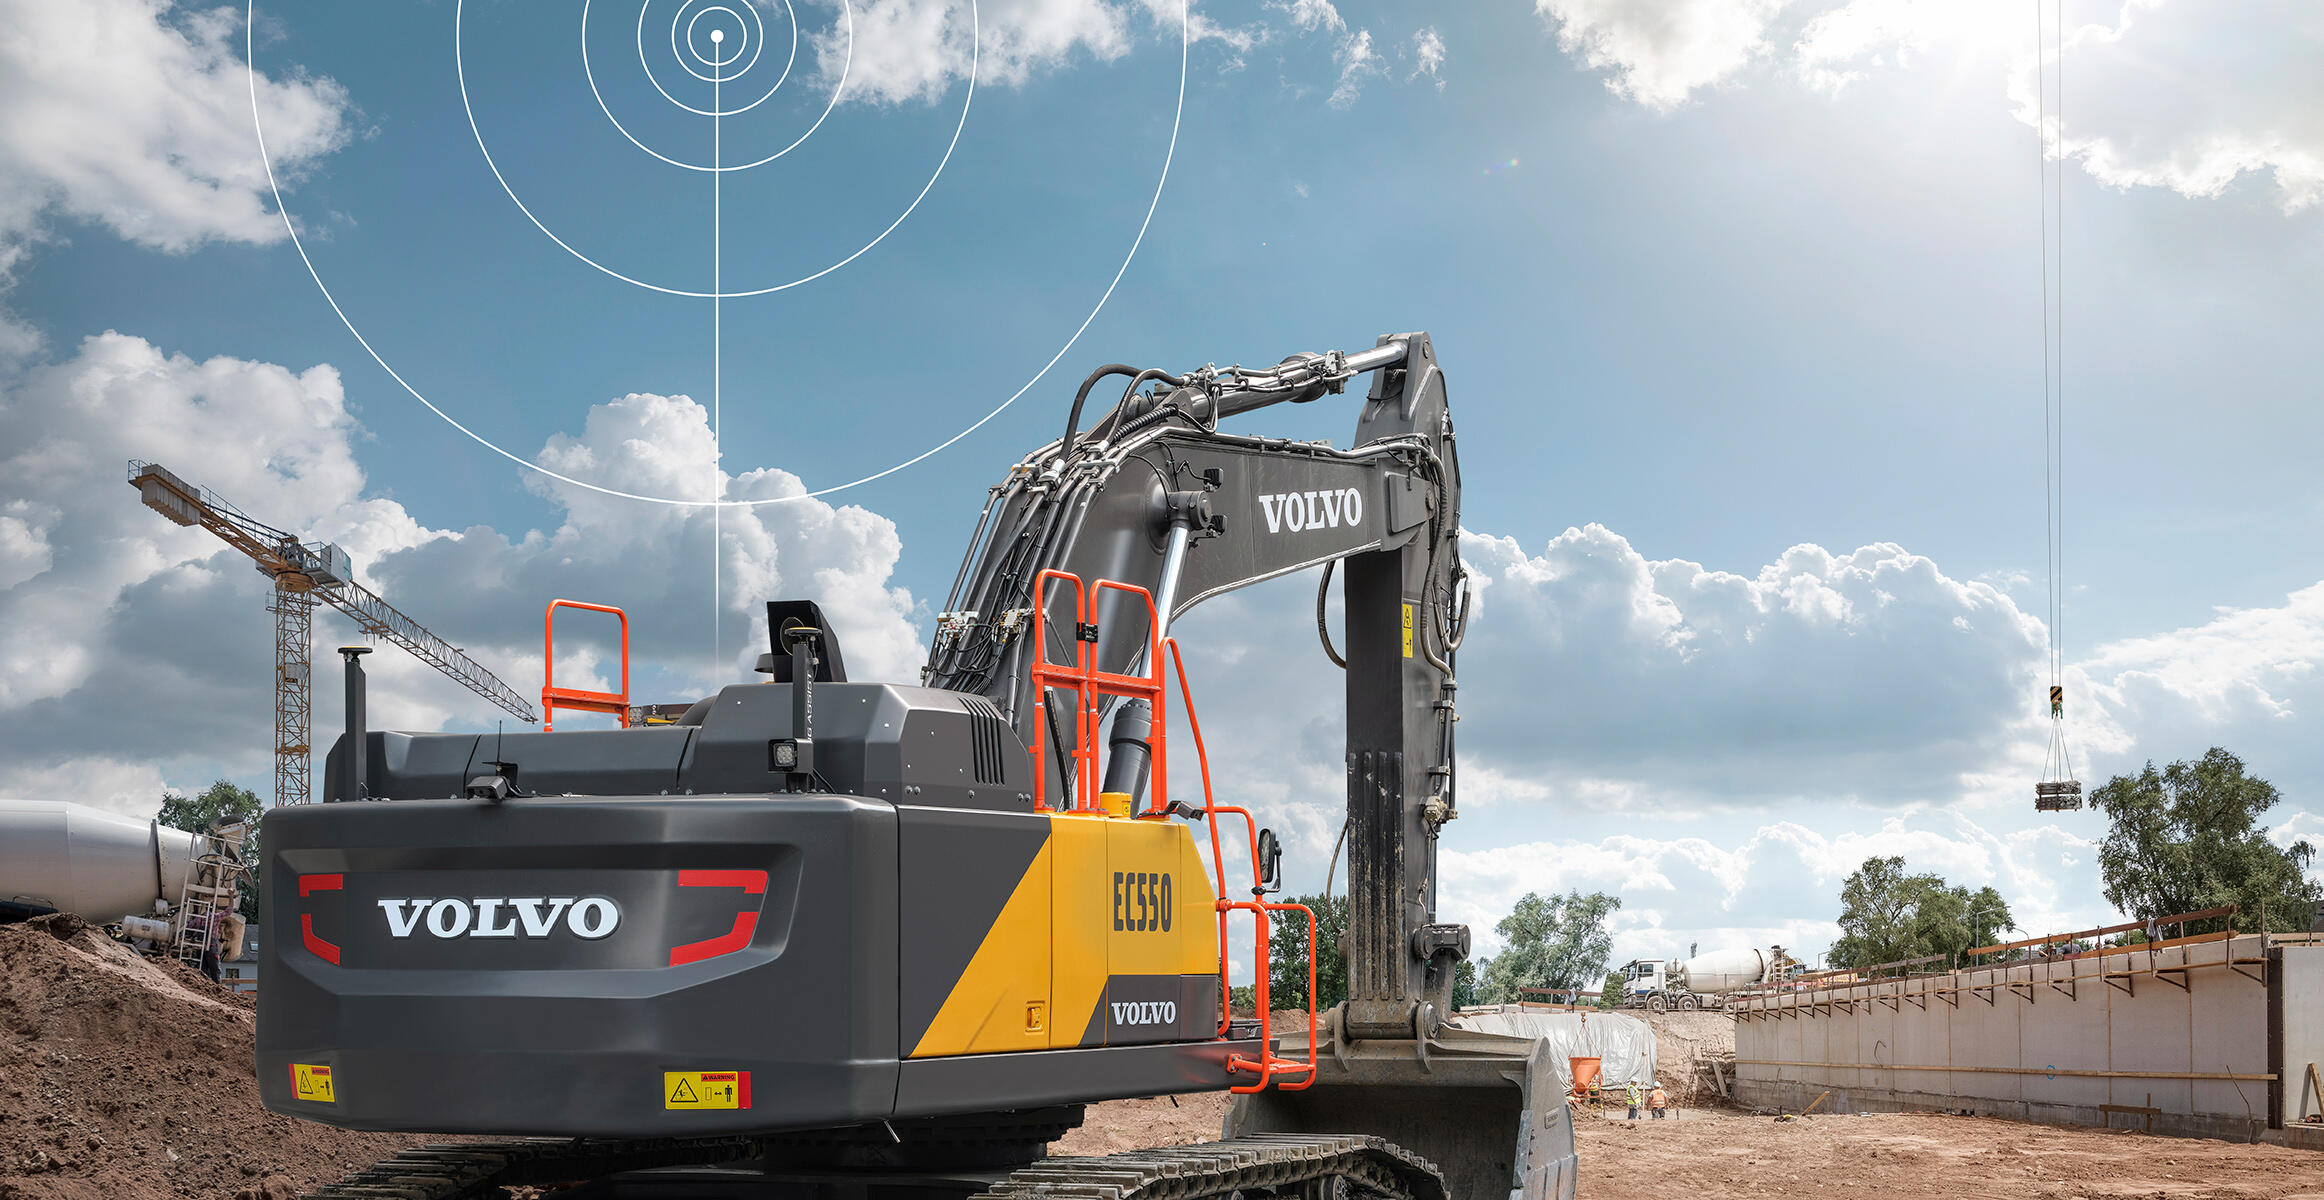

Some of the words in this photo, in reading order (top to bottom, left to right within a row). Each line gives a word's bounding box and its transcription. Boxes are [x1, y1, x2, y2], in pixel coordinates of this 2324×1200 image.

[1258, 487, 1363, 534] VOLVO
[377, 897, 621, 939] VOLVO
[1113, 871, 1172, 933] EC550
[1110, 1000, 1177, 1026] VOLVO
